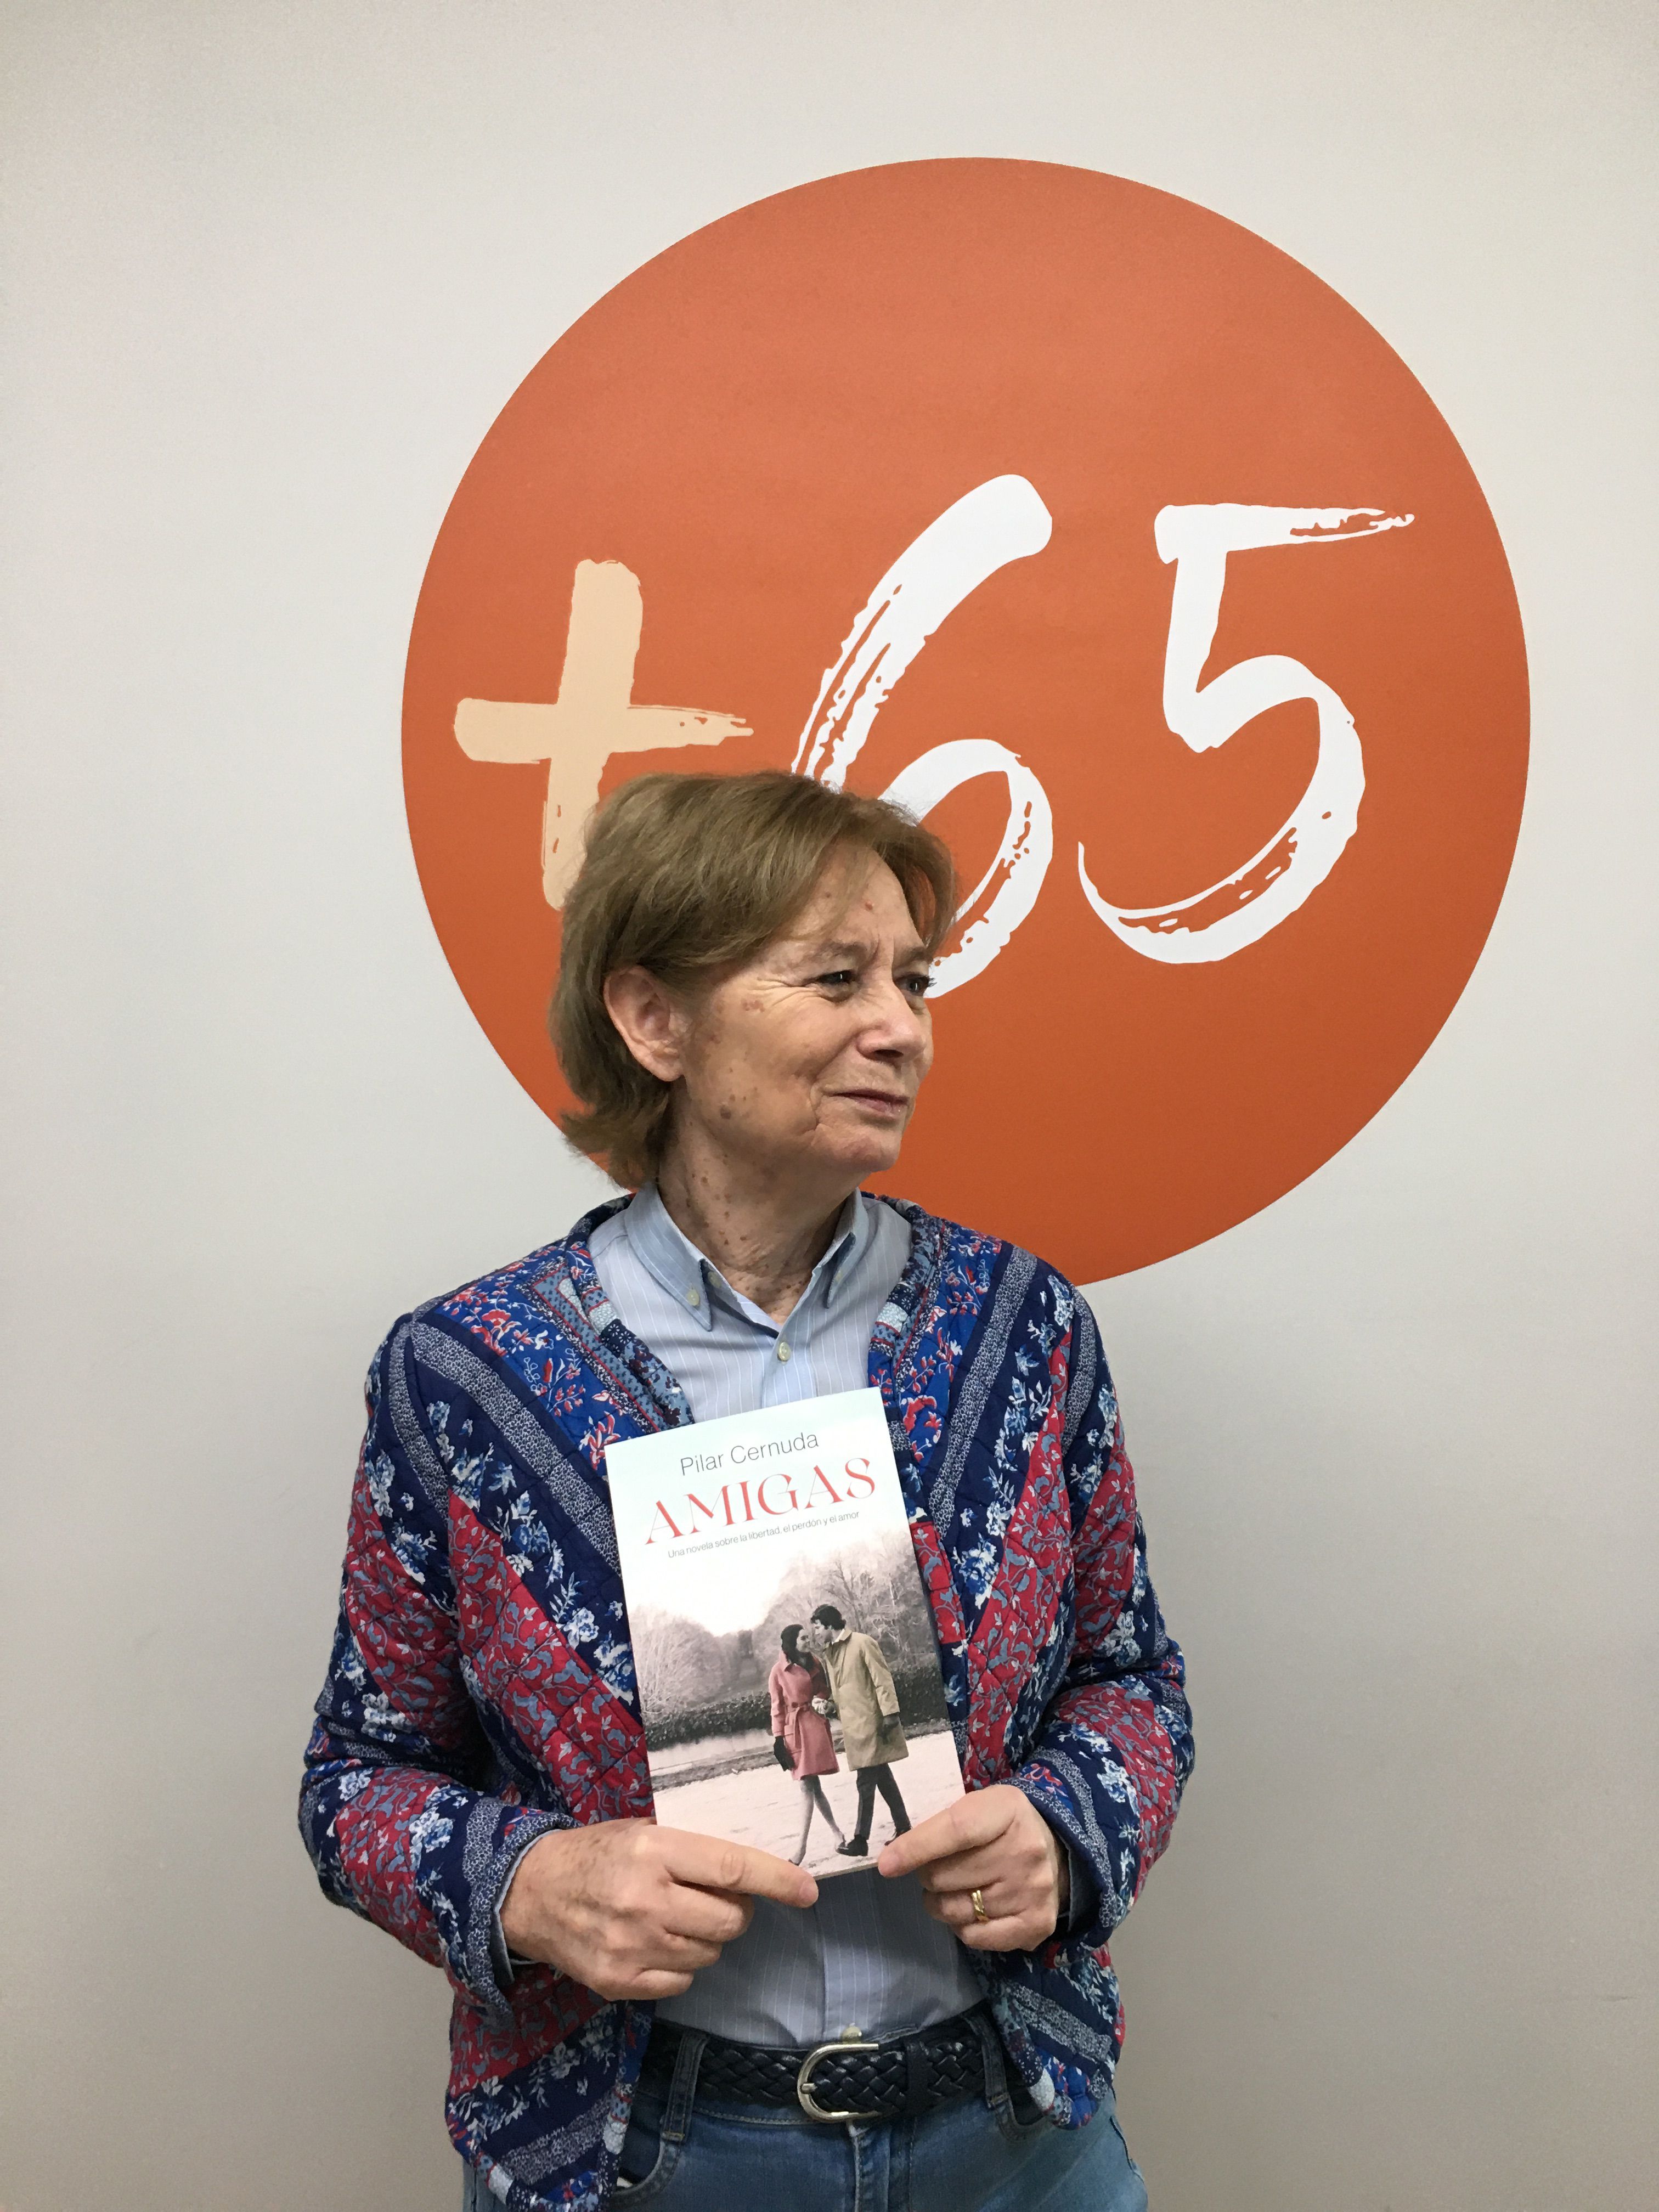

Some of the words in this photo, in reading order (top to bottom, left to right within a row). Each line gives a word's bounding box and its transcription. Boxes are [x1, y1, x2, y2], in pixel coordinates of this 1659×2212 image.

[680, 1452, 725, 1476] Pilar
[730, 1432, 820, 1464] Cernuda
[645, 1458, 876, 1545] AMIGAS
[668, 1549, 685, 1558] Una
[686, 1541, 714, 1554] novela
[714, 1536, 739, 1548] sobre
[740, 1534, 748, 1542] la
[783, 1524, 791, 1533] el
[792, 1519, 822, 1532] perdón
[822, 1517, 828, 1526] y
[829, 1515, 837, 1523] el
[838, 1511, 860, 1521] amor
